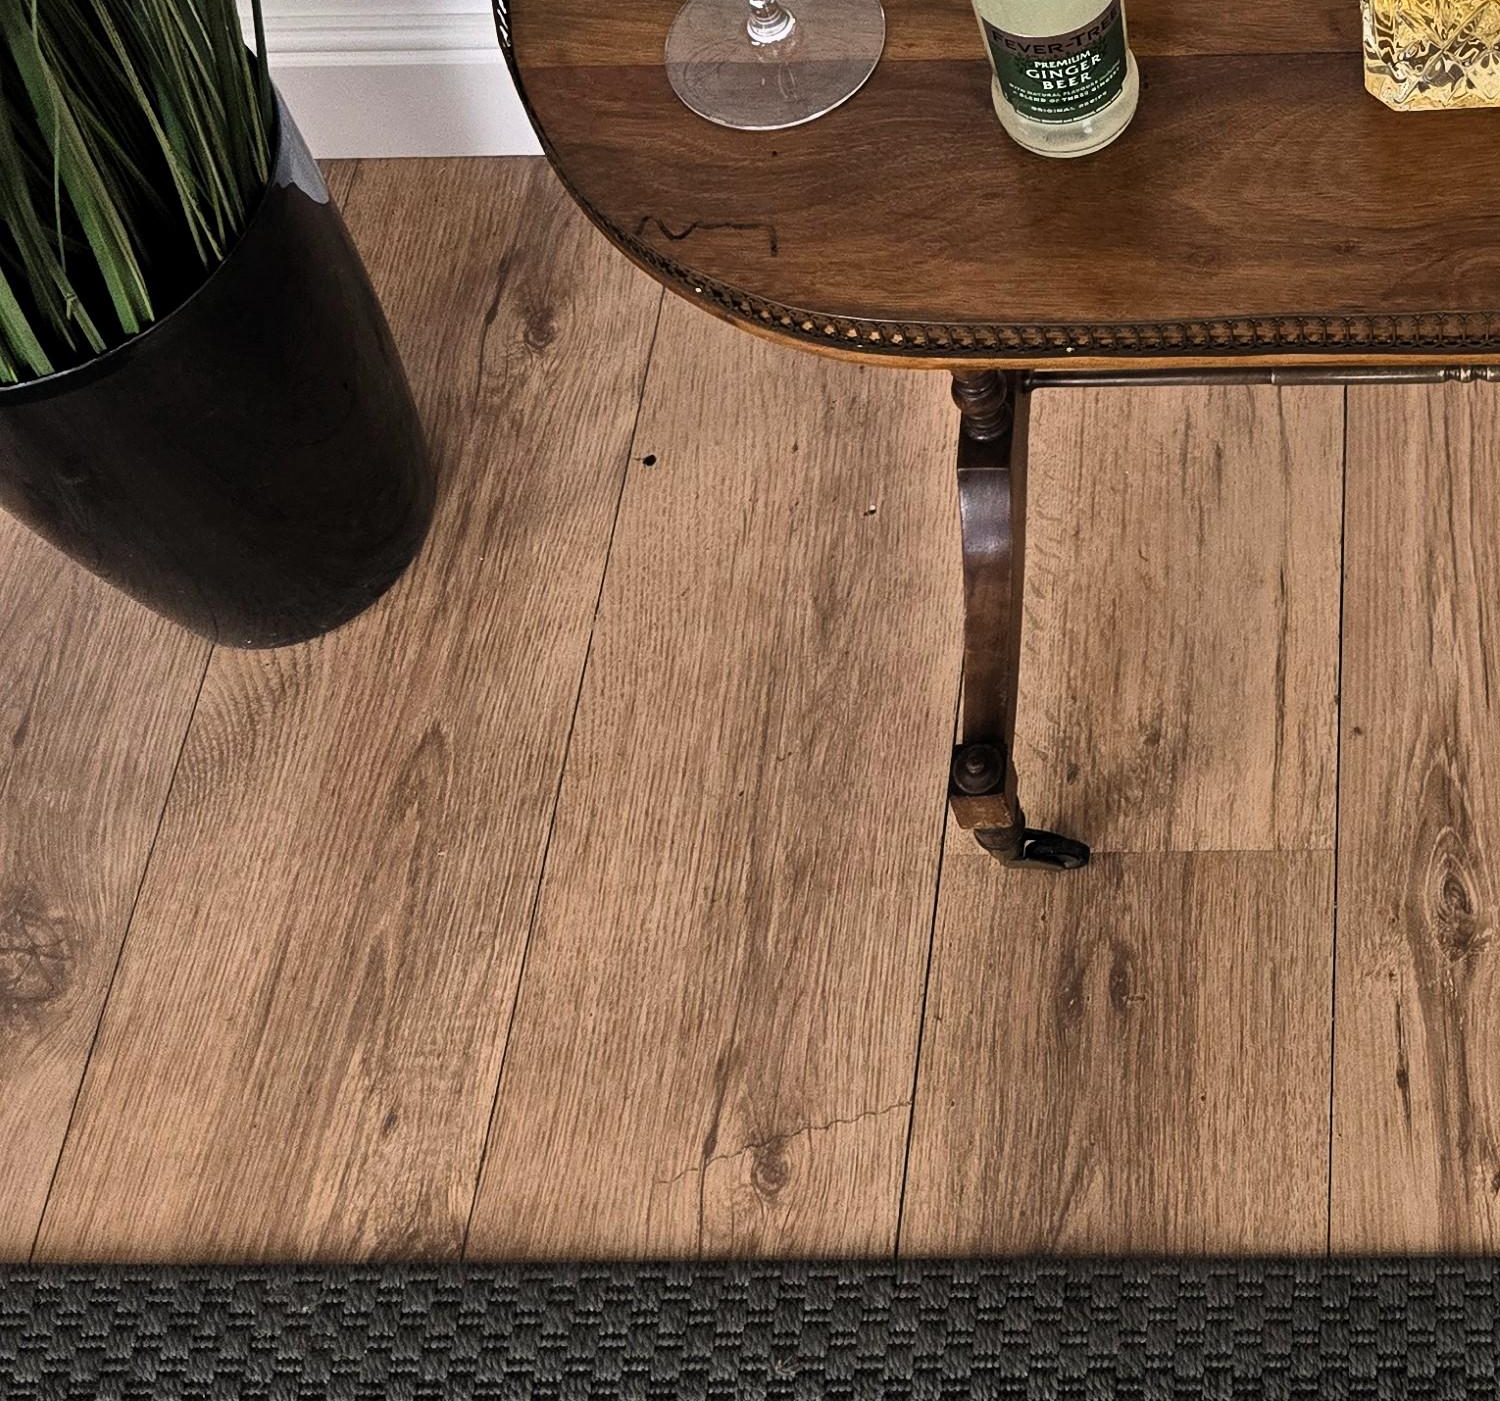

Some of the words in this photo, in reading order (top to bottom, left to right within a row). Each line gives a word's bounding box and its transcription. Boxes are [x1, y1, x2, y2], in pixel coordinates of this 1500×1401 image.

[991, 7, 1119, 55] FEVER-TREE
[1026, 54, 1101, 79] GINGER
[1034, 50, 1091, 69] PREMIUM
[1043, 73, 1092, 90] BEER
